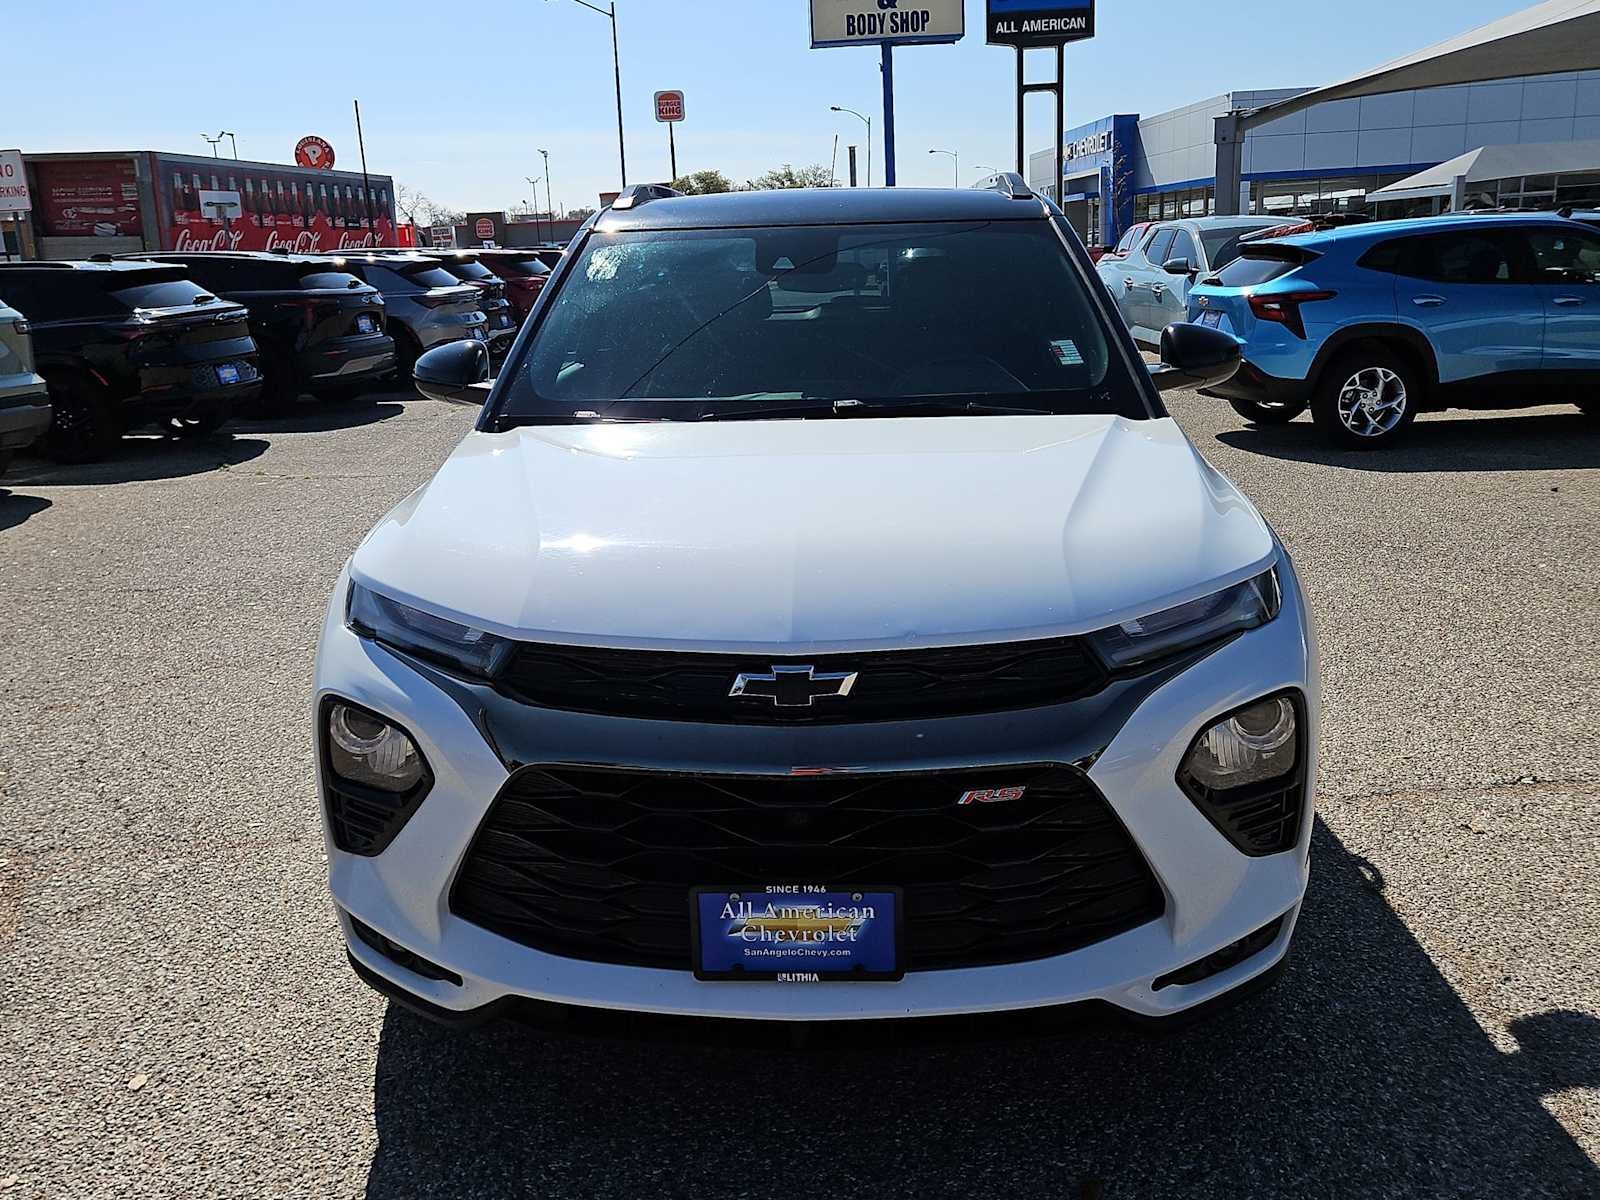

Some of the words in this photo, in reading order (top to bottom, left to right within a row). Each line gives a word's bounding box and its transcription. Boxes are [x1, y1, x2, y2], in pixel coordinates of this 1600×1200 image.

[846, 13, 886, 36] BODY
[890, 10, 929, 33] SHOP
[996, 21, 1018, 33] ALL
[1022, 17, 1086, 32] AMERICAN
[658, 106, 681, 114] KING
[1072, 131, 1112, 158] CHEVROLET
[0, 185, 27, 197] RKING
[174, 228, 244, 251] Coca-Cl
[957, 786, 1026, 804] RS
[765, 885, 799, 894] SINCE
[802, 885, 827, 894] 1946
[719, 901, 752, 919] All
[763, 902, 875, 920] American
[740, 924, 858, 943] Chevrolet
[744, 948, 851, 958] SanAngeloChevy.com
[786, 973, 819, 982] LITHIA
